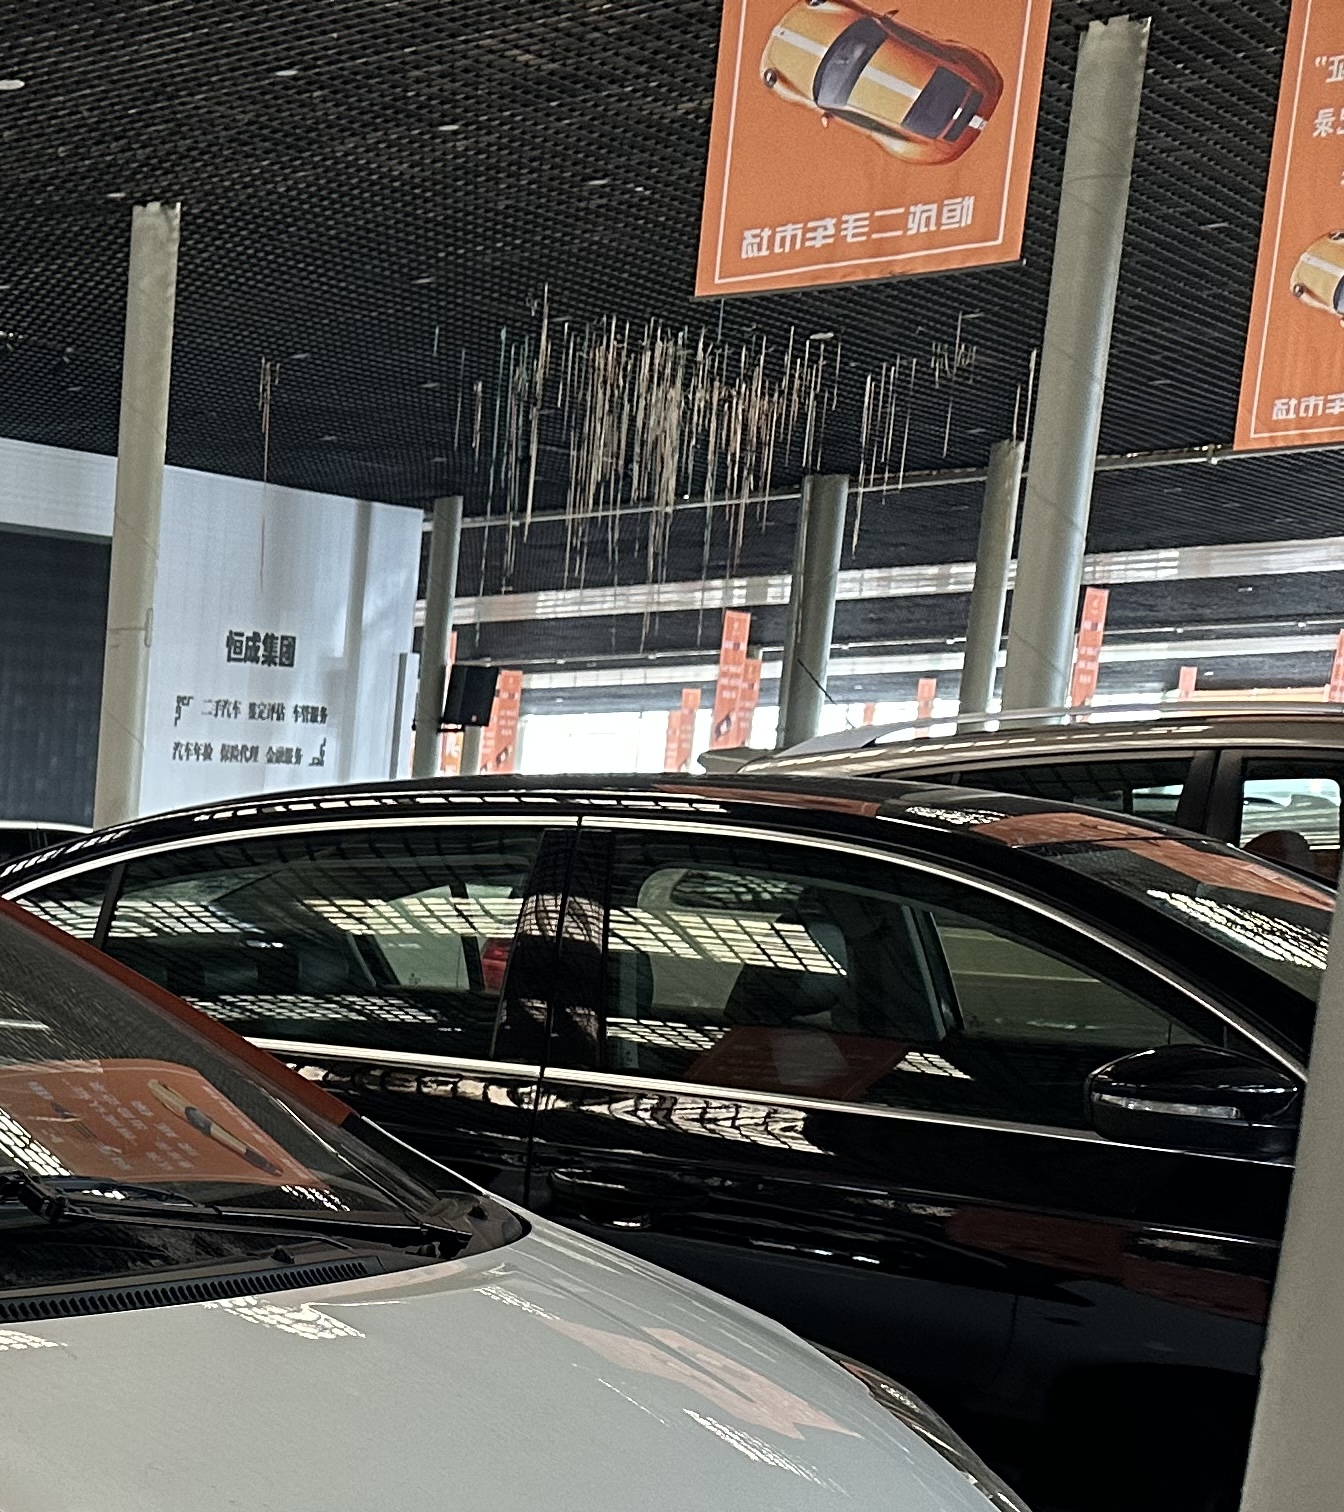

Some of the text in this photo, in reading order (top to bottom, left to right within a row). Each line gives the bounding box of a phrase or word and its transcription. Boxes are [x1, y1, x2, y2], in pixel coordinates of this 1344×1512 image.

[226, 629, 297, 668] 恒成集团
[201, 699, 242, 719] 二手汽车
